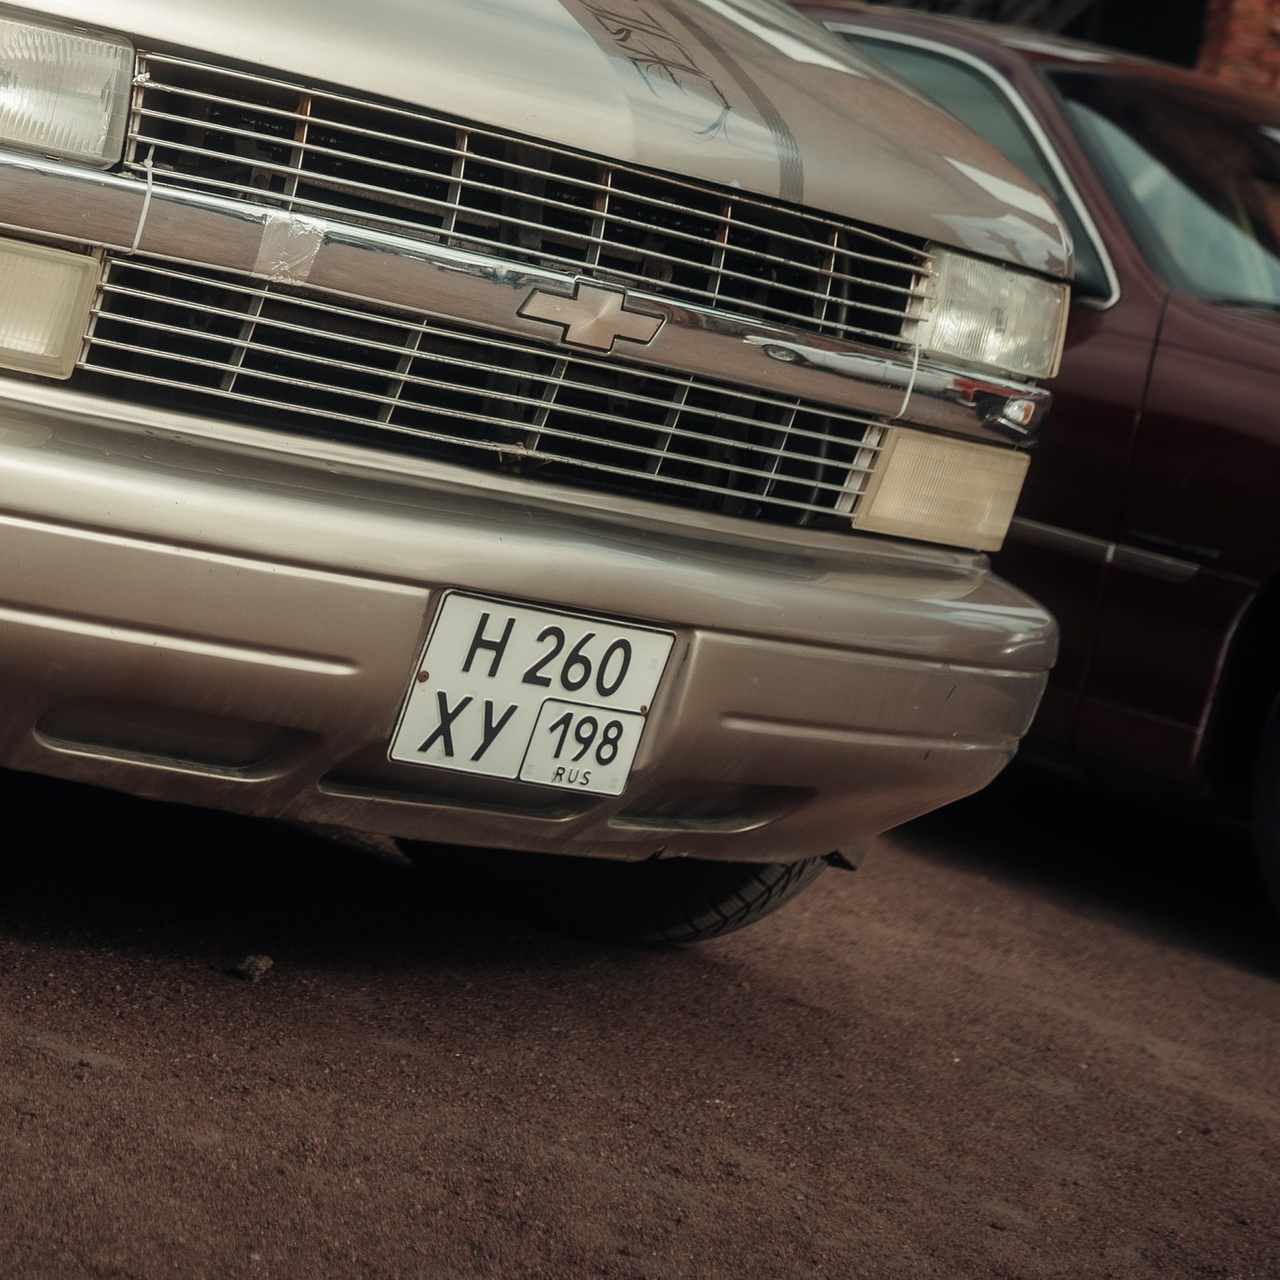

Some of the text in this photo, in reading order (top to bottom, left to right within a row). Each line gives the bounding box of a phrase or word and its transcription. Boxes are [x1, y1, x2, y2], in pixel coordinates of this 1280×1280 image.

[521, 625, 632, 697] 260
[549, 712, 624, 766] 198
[552, 766, 592, 786] RUS
